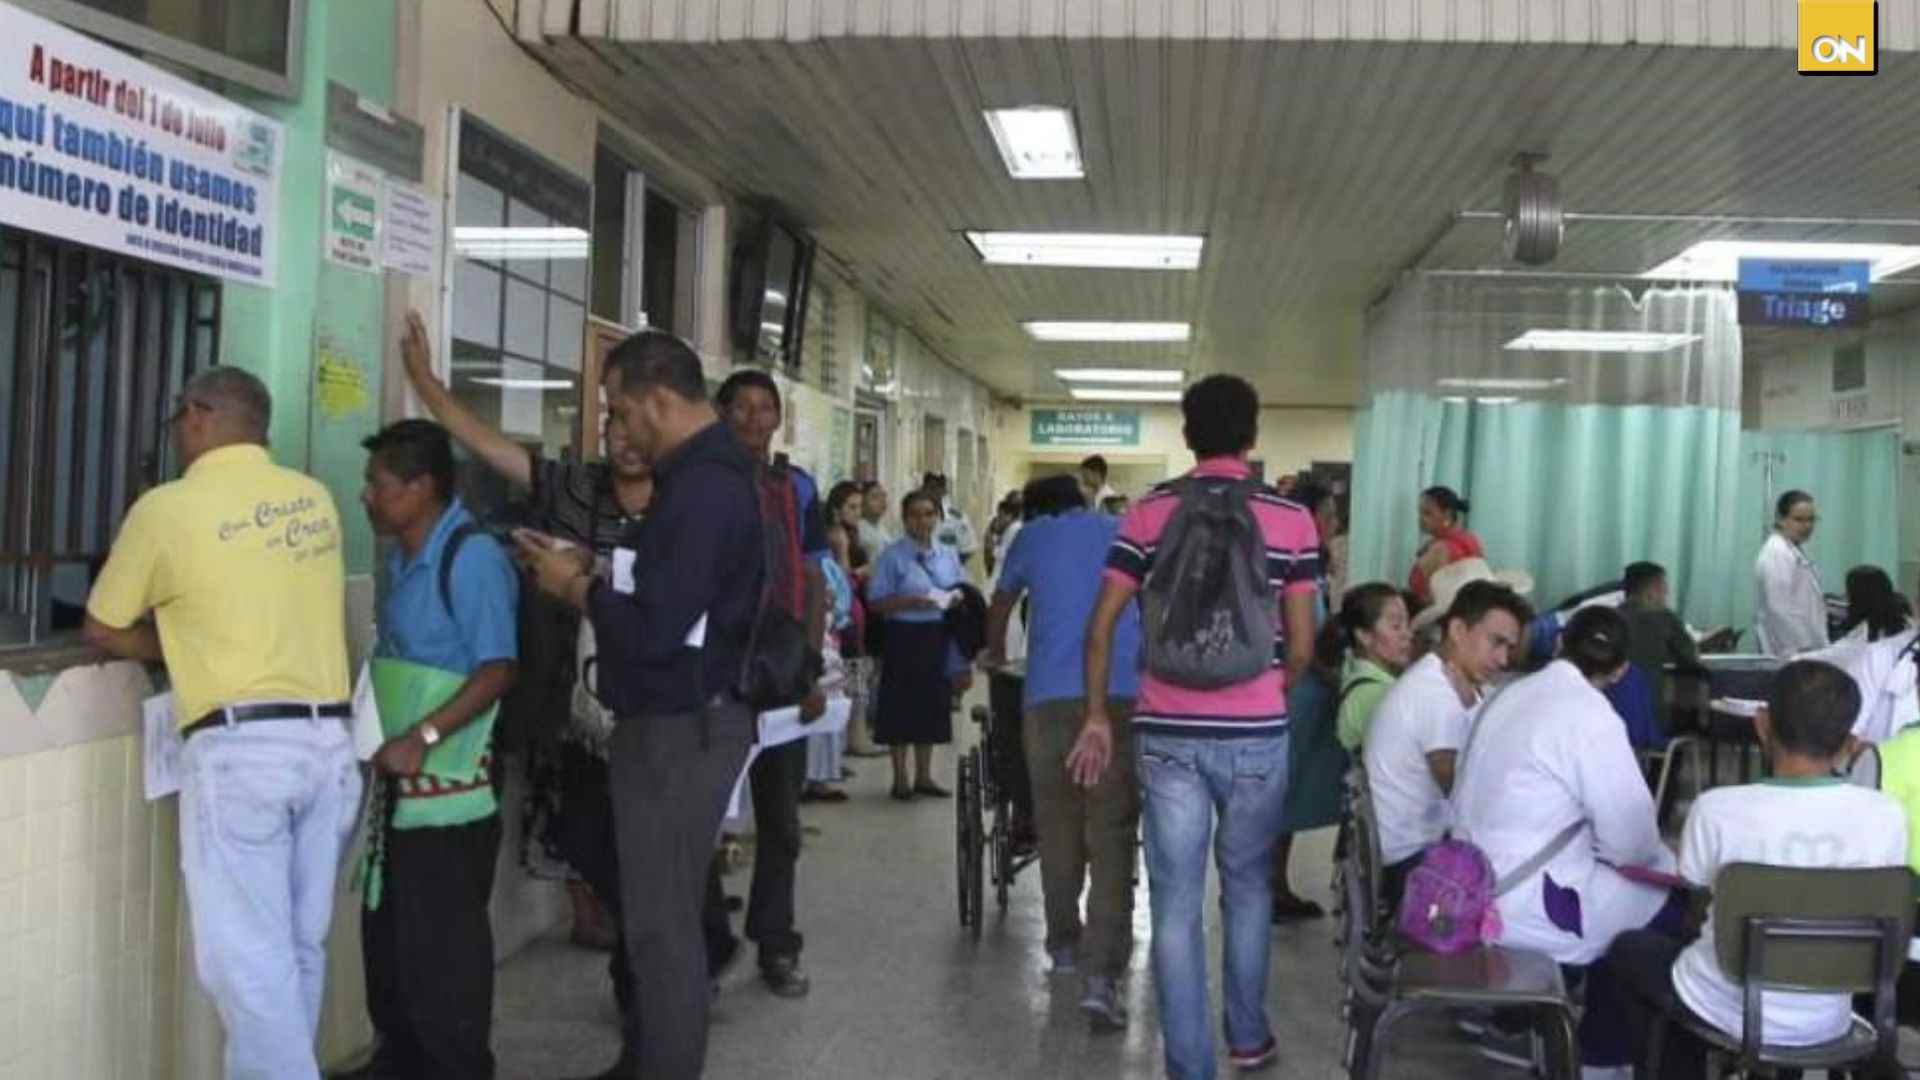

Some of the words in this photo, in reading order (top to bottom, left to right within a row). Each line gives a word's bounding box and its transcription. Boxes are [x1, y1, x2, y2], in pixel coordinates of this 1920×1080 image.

[30, 44, 44, 84] A
[50, 57, 111, 107] partir
[115, 79, 145, 122] del
[162, 100, 183, 136] de
[0, 150, 111, 216] número
[117, 184, 150, 227] de
[53, 113, 164, 186] también
[169, 158, 257, 216] usamos
[1761, 294, 1846, 325] Triage
[1037, 423, 1133, 435] LABORATORIO
